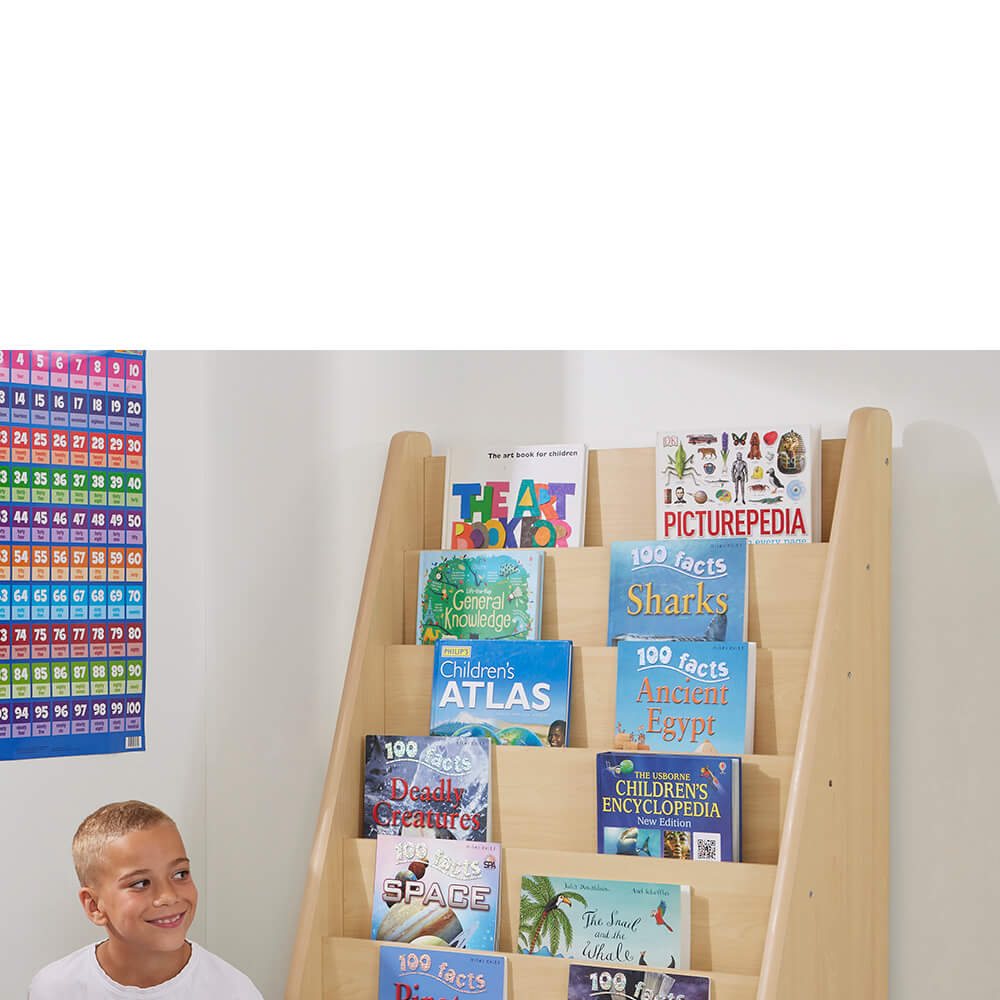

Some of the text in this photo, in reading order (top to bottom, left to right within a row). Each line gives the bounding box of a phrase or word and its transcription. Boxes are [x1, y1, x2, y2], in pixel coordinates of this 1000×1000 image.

[16, 392, 25, 405] 14
[35, 394, 44, 407] 15
[55, 396, 64, 408] 16
[74, 397, 83, 409] 17
[93, 399, 102, 411] 18
[112, 400, 120, 412] 19
[128, 401, 140, 414] 20
[536, 450, 547, 458] for
[14, 471, 27, 484] 34
[34, 472, 47, 485] 35
[54, 473, 66, 486] 36
[74, 474, 85, 486] 37
[92, 475, 104, 487] 38
[111, 476, 122, 488] 39
[128, 478, 141, 489] 40
[452, 479, 576, 523] THE ART
[451, 517, 522, 549] BOOK
[663, 508, 806, 537] PICTUREPEDIA
[15, 550, 28, 562] 54
[35, 551, 47, 563] 55
[54, 551, 67, 563] 56
[74, 552, 85, 563] 57
[92, 552, 104, 564] 58
[111, 552, 122, 564] 59
[128, 552, 141, 564] 60
[631, 545, 728, 576] 100 facts
[453, 590, 505, 611] General
[627, 581, 728, 616] Sharks
[444, 607, 511, 633] Knowledge
[440, 660, 515, 680] Children's
[636, 646, 729, 679] 100 facts
[439, 681, 551, 711] ATLAS
[636, 677, 729, 705] Ancient
[15, 707, 28, 719] 94
[35, 706, 48, 718] 95
[55, 705, 68, 717] 96
[75, 705, 86, 716] 97
[93, 703, 106, 715] 98
[112, 703, 122, 714] 99
[127, 702, 140, 713] 100
[646, 707, 716, 743] Egypt
[384, 740, 472, 772] 100 facts
[635, 771, 691, 781] THE USBORNE
[390, 777, 465, 808] Deadly
[615, 779, 708, 801] CHILDREN'S
[372, 800, 481, 831] Creatures
[602, 797, 722, 818] ENCYCLOPEDIA
[637, 816, 692, 828] New Edition
[395, 841, 481, 877] 100 facts
[382, 878, 491, 912] SPACE
[582, 910, 641, 932] The Snail
[595, 931, 625, 940] and the
[583, 941, 634, 962] Whale
[399, 953, 486, 990] 100 facts
[590, 972, 627, 991] 100
